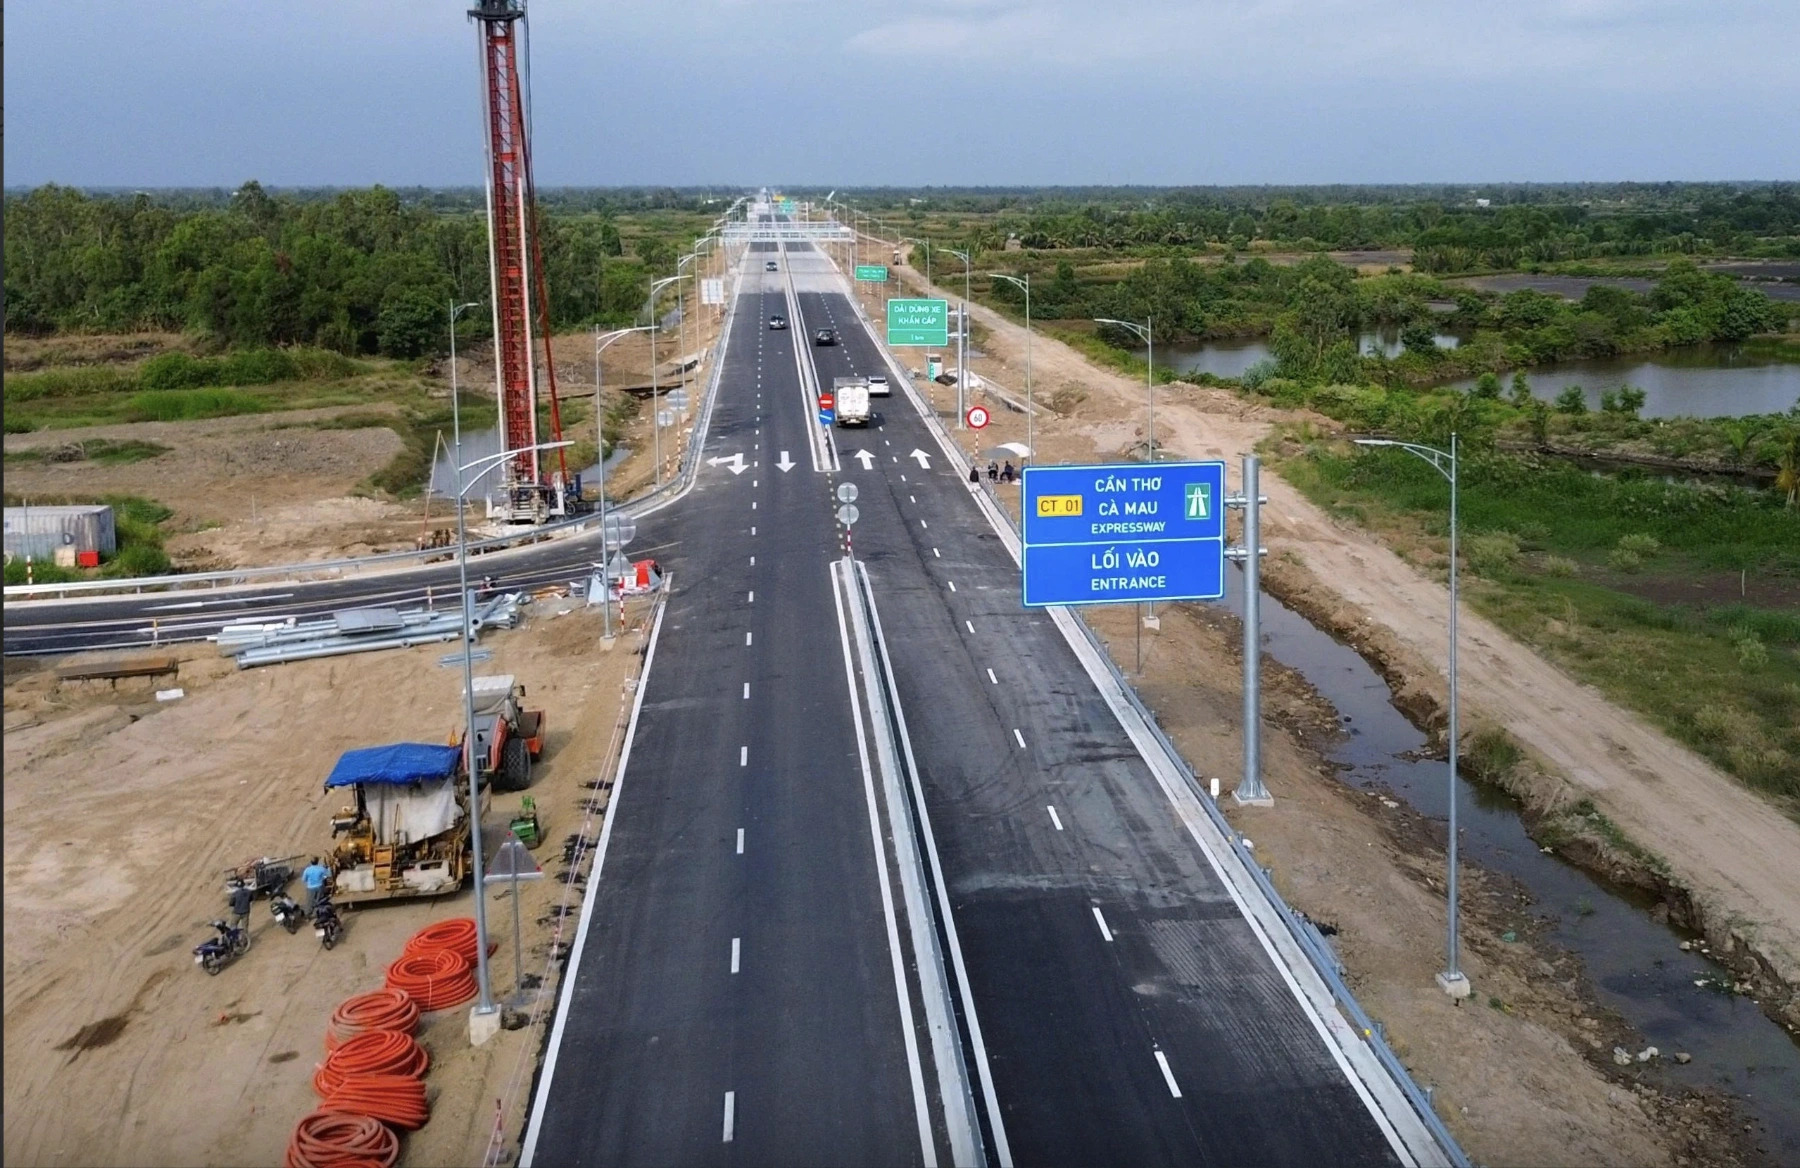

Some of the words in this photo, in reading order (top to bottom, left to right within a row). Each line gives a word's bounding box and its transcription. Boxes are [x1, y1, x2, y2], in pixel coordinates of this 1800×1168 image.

[974, 414, 982, 422] 60
[1095, 475, 1127, 493] CẦN
[1131, 476, 1162, 491] THƠ
[1065, 499, 1079, 512] 01
[1098, 500, 1119, 516] CÀ
[1125, 501, 1158, 515] MAU
[1091, 521, 1166, 534] EXPRESSWAY
[1091, 547, 1120, 569] LỐI
[1126, 548, 1160, 568] VÀO
[1091, 576, 1166, 591] ENTRANCE
